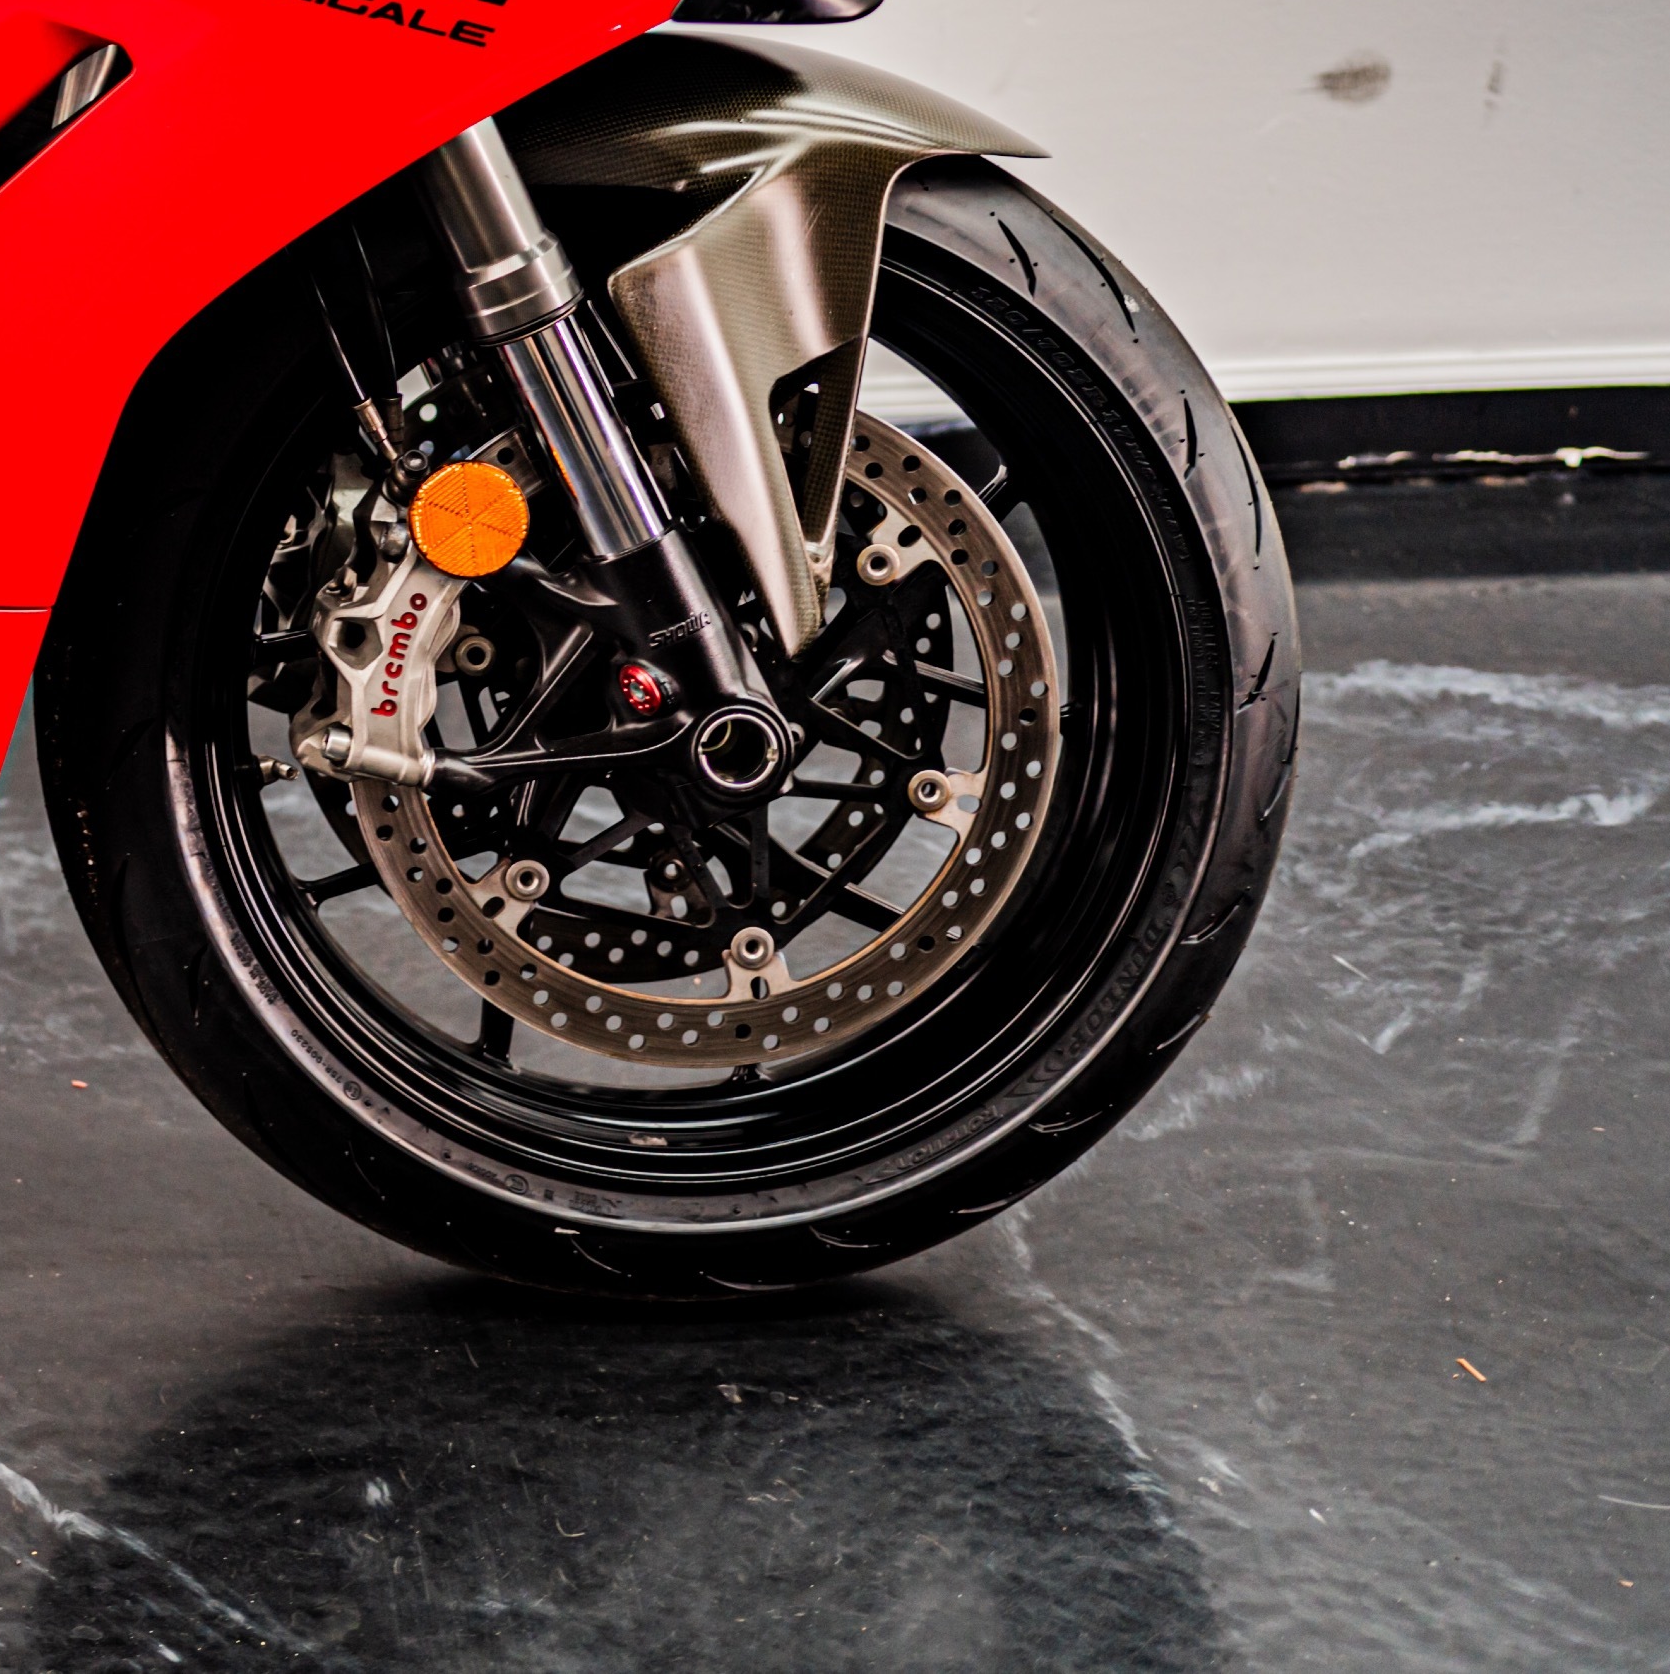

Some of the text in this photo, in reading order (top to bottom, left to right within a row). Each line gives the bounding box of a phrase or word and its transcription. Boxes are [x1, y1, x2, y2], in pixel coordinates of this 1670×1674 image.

[370, 593, 428, 717] brembo
[648, 610, 711, 646] SHOWA
[1059, 917, 1165, 1062] DUNLOP
